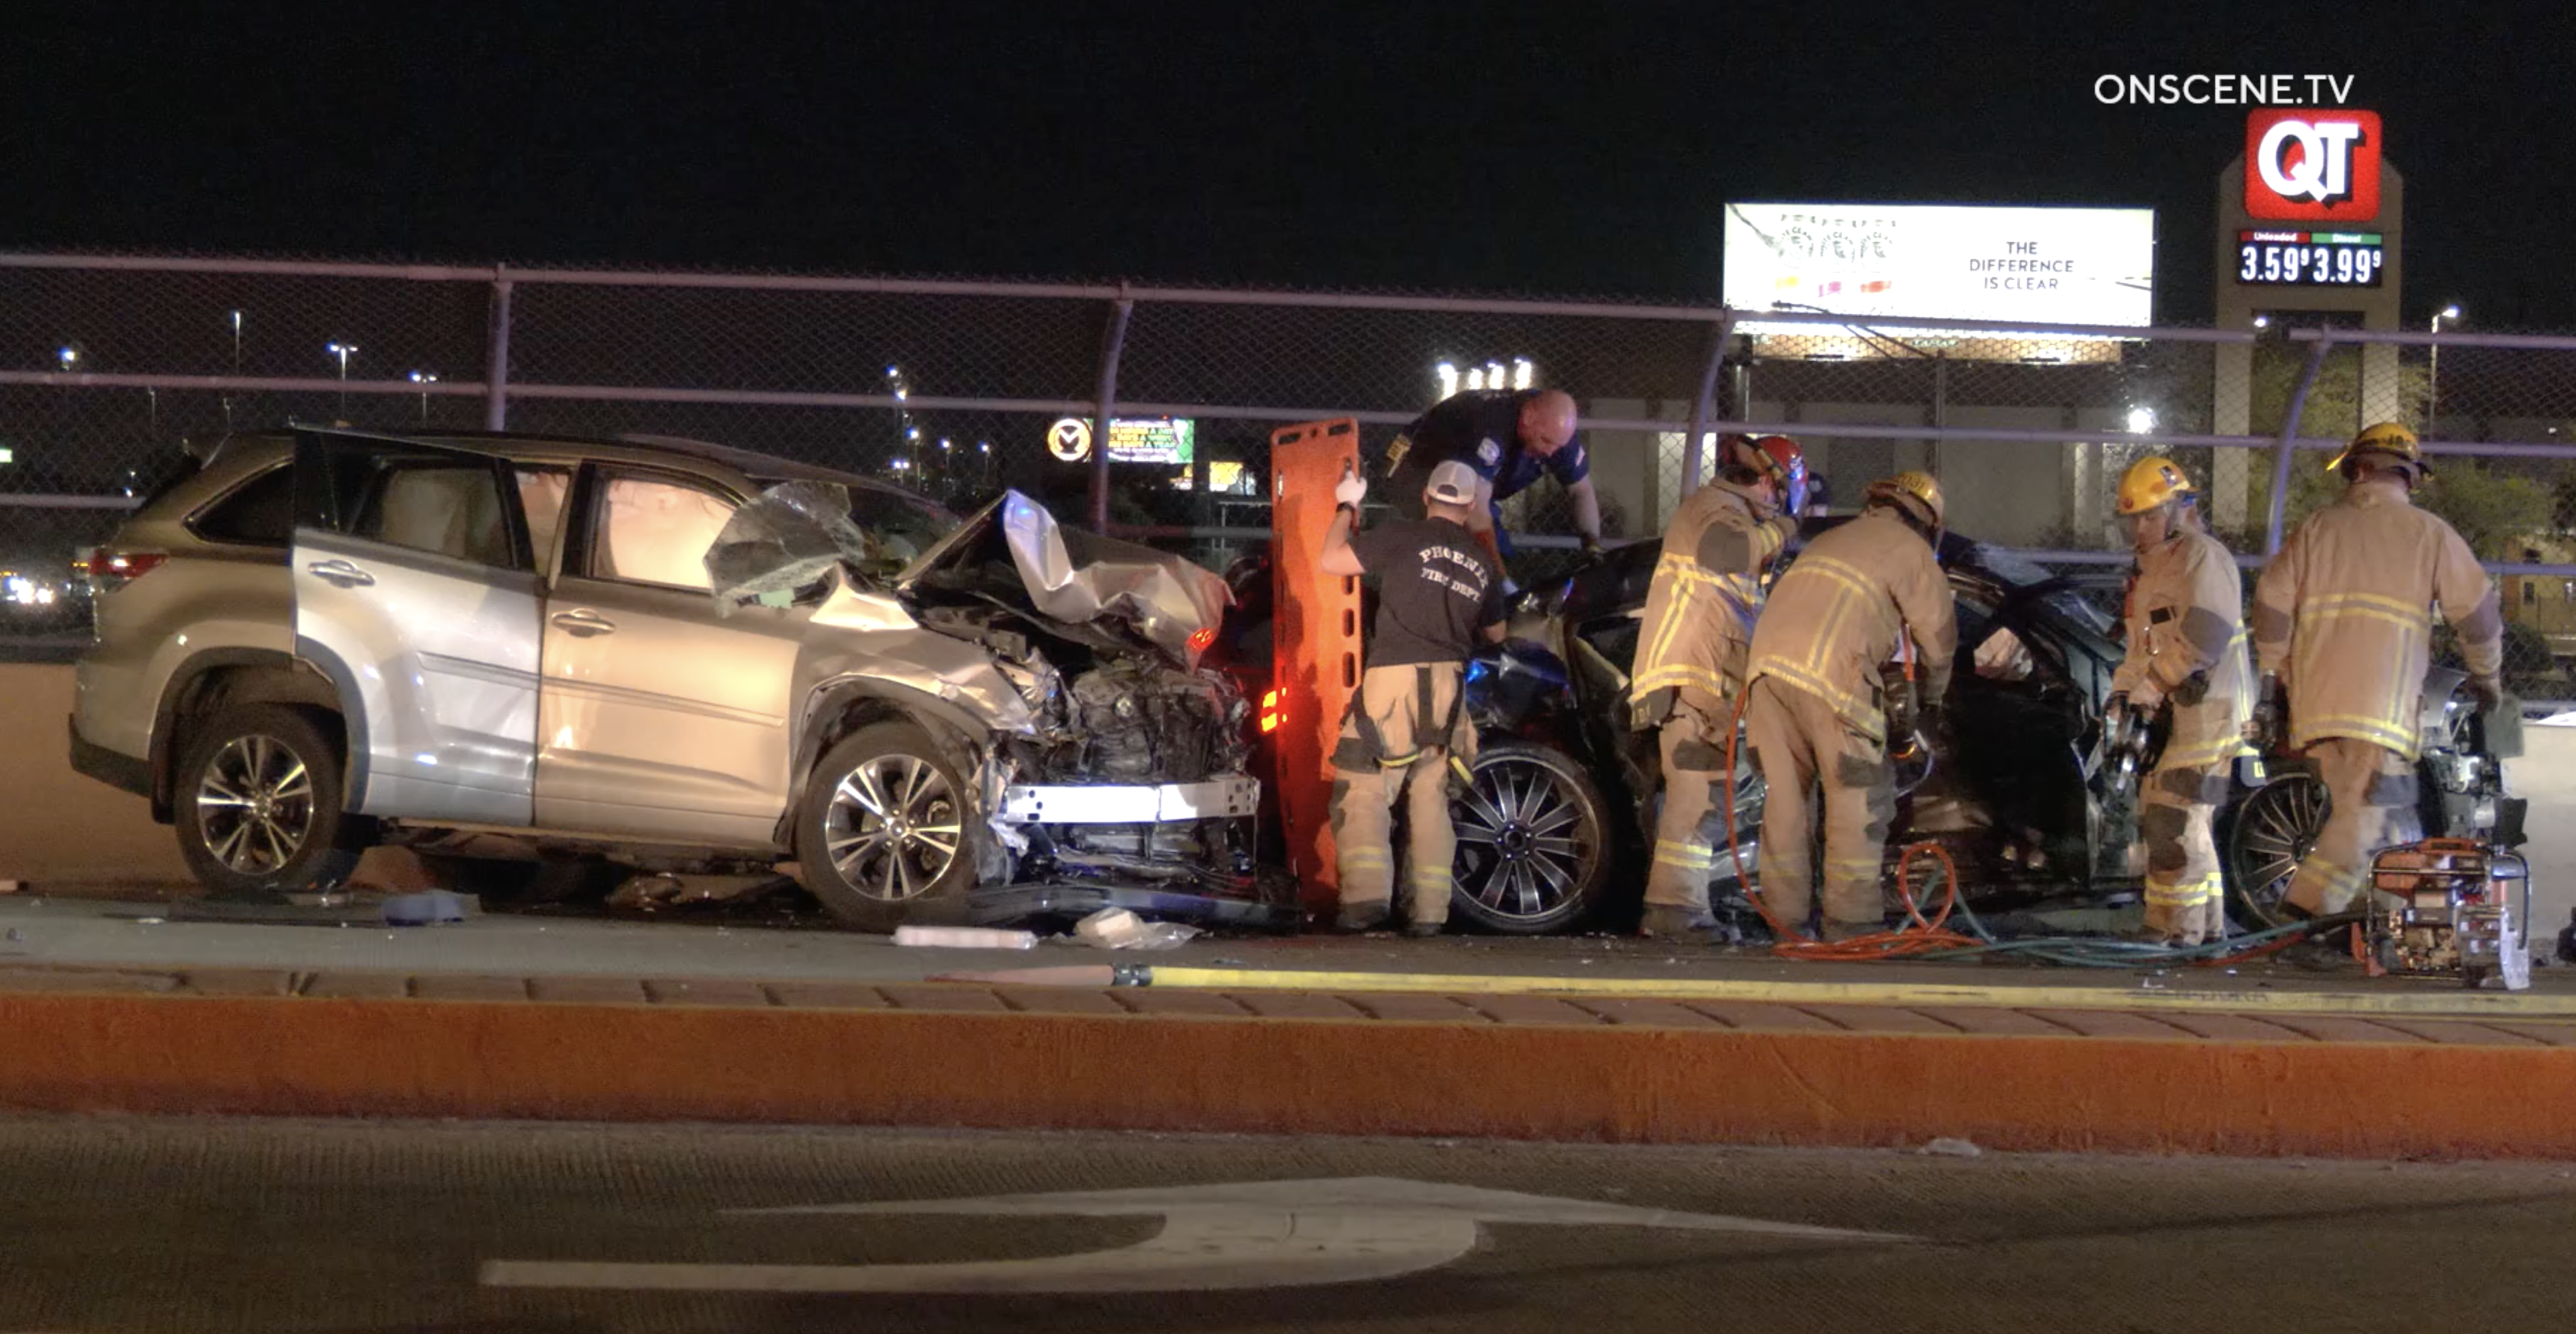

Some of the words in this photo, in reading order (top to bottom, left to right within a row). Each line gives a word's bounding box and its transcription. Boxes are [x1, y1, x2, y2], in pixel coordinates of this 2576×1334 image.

[2258, 120, 2362, 202] QT
[2253, 231, 2297, 242] Unleaded
[2331, 233, 2362, 243] Diesel
[2006, 241, 2038, 255] THE
[1969, 258, 2075, 272] DIFFERENCE
[1984, 277, 1999, 289] IS
[2004, 277, 2059, 291] CLEAR
[1419, 545, 1489, 589] PHOENIX
[1421, 567, 1449, 586] FIRE
